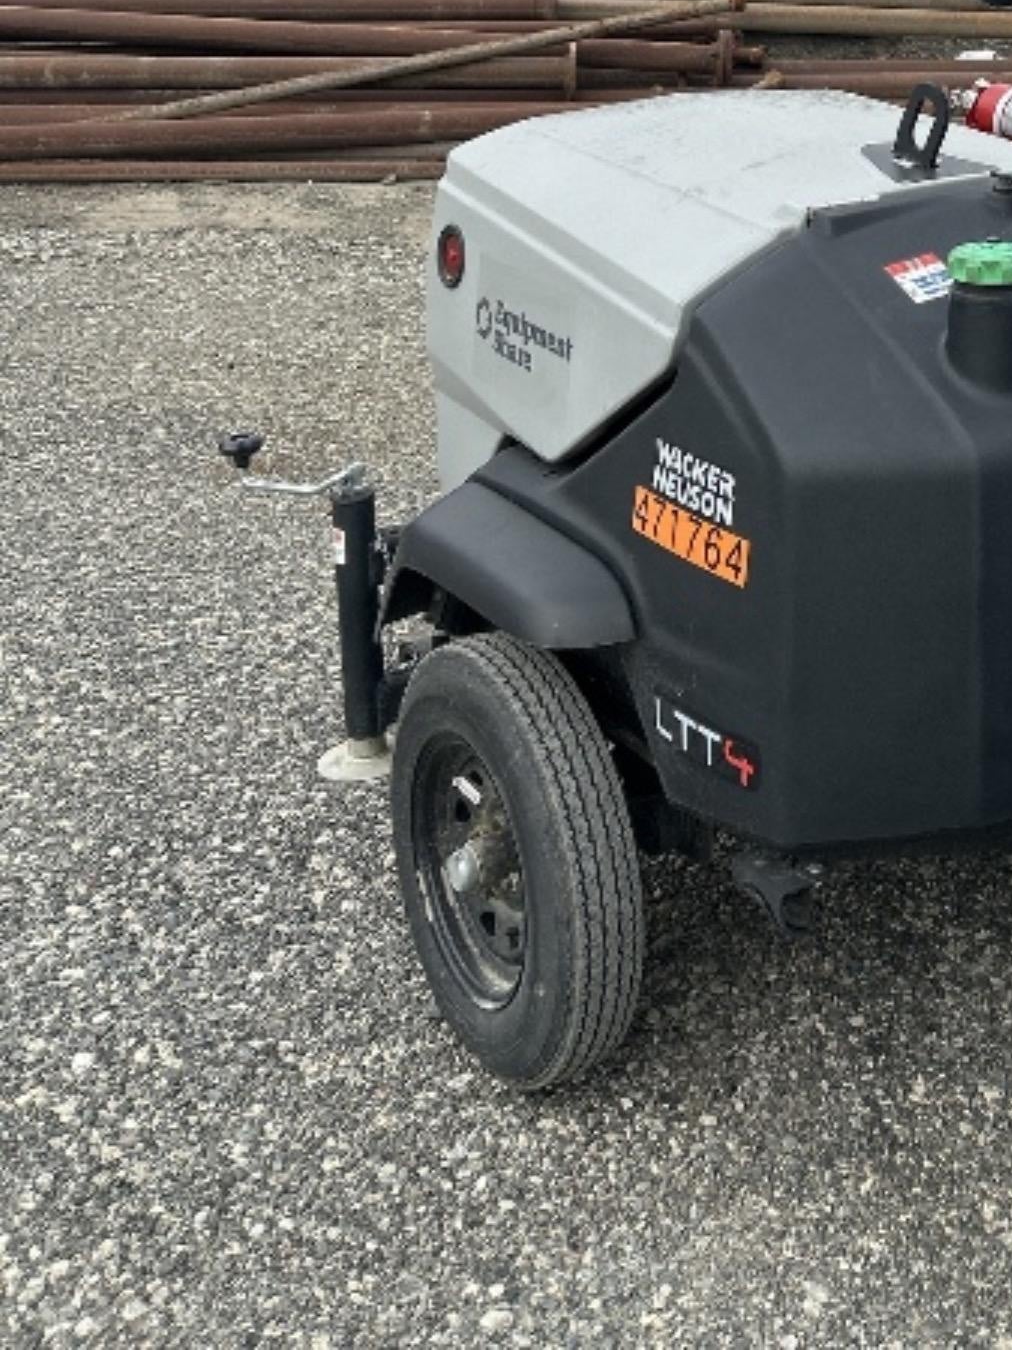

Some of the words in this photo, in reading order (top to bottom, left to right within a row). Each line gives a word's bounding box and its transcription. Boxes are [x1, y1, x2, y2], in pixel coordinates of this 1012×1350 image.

[496, 299, 574, 363] Equipment
[652, 464, 734, 526] NEUSON
[656, 437, 736, 502] WACKER
[635, 493, 743, 580] 471764
[654, 696, 755, 787] LTT4
